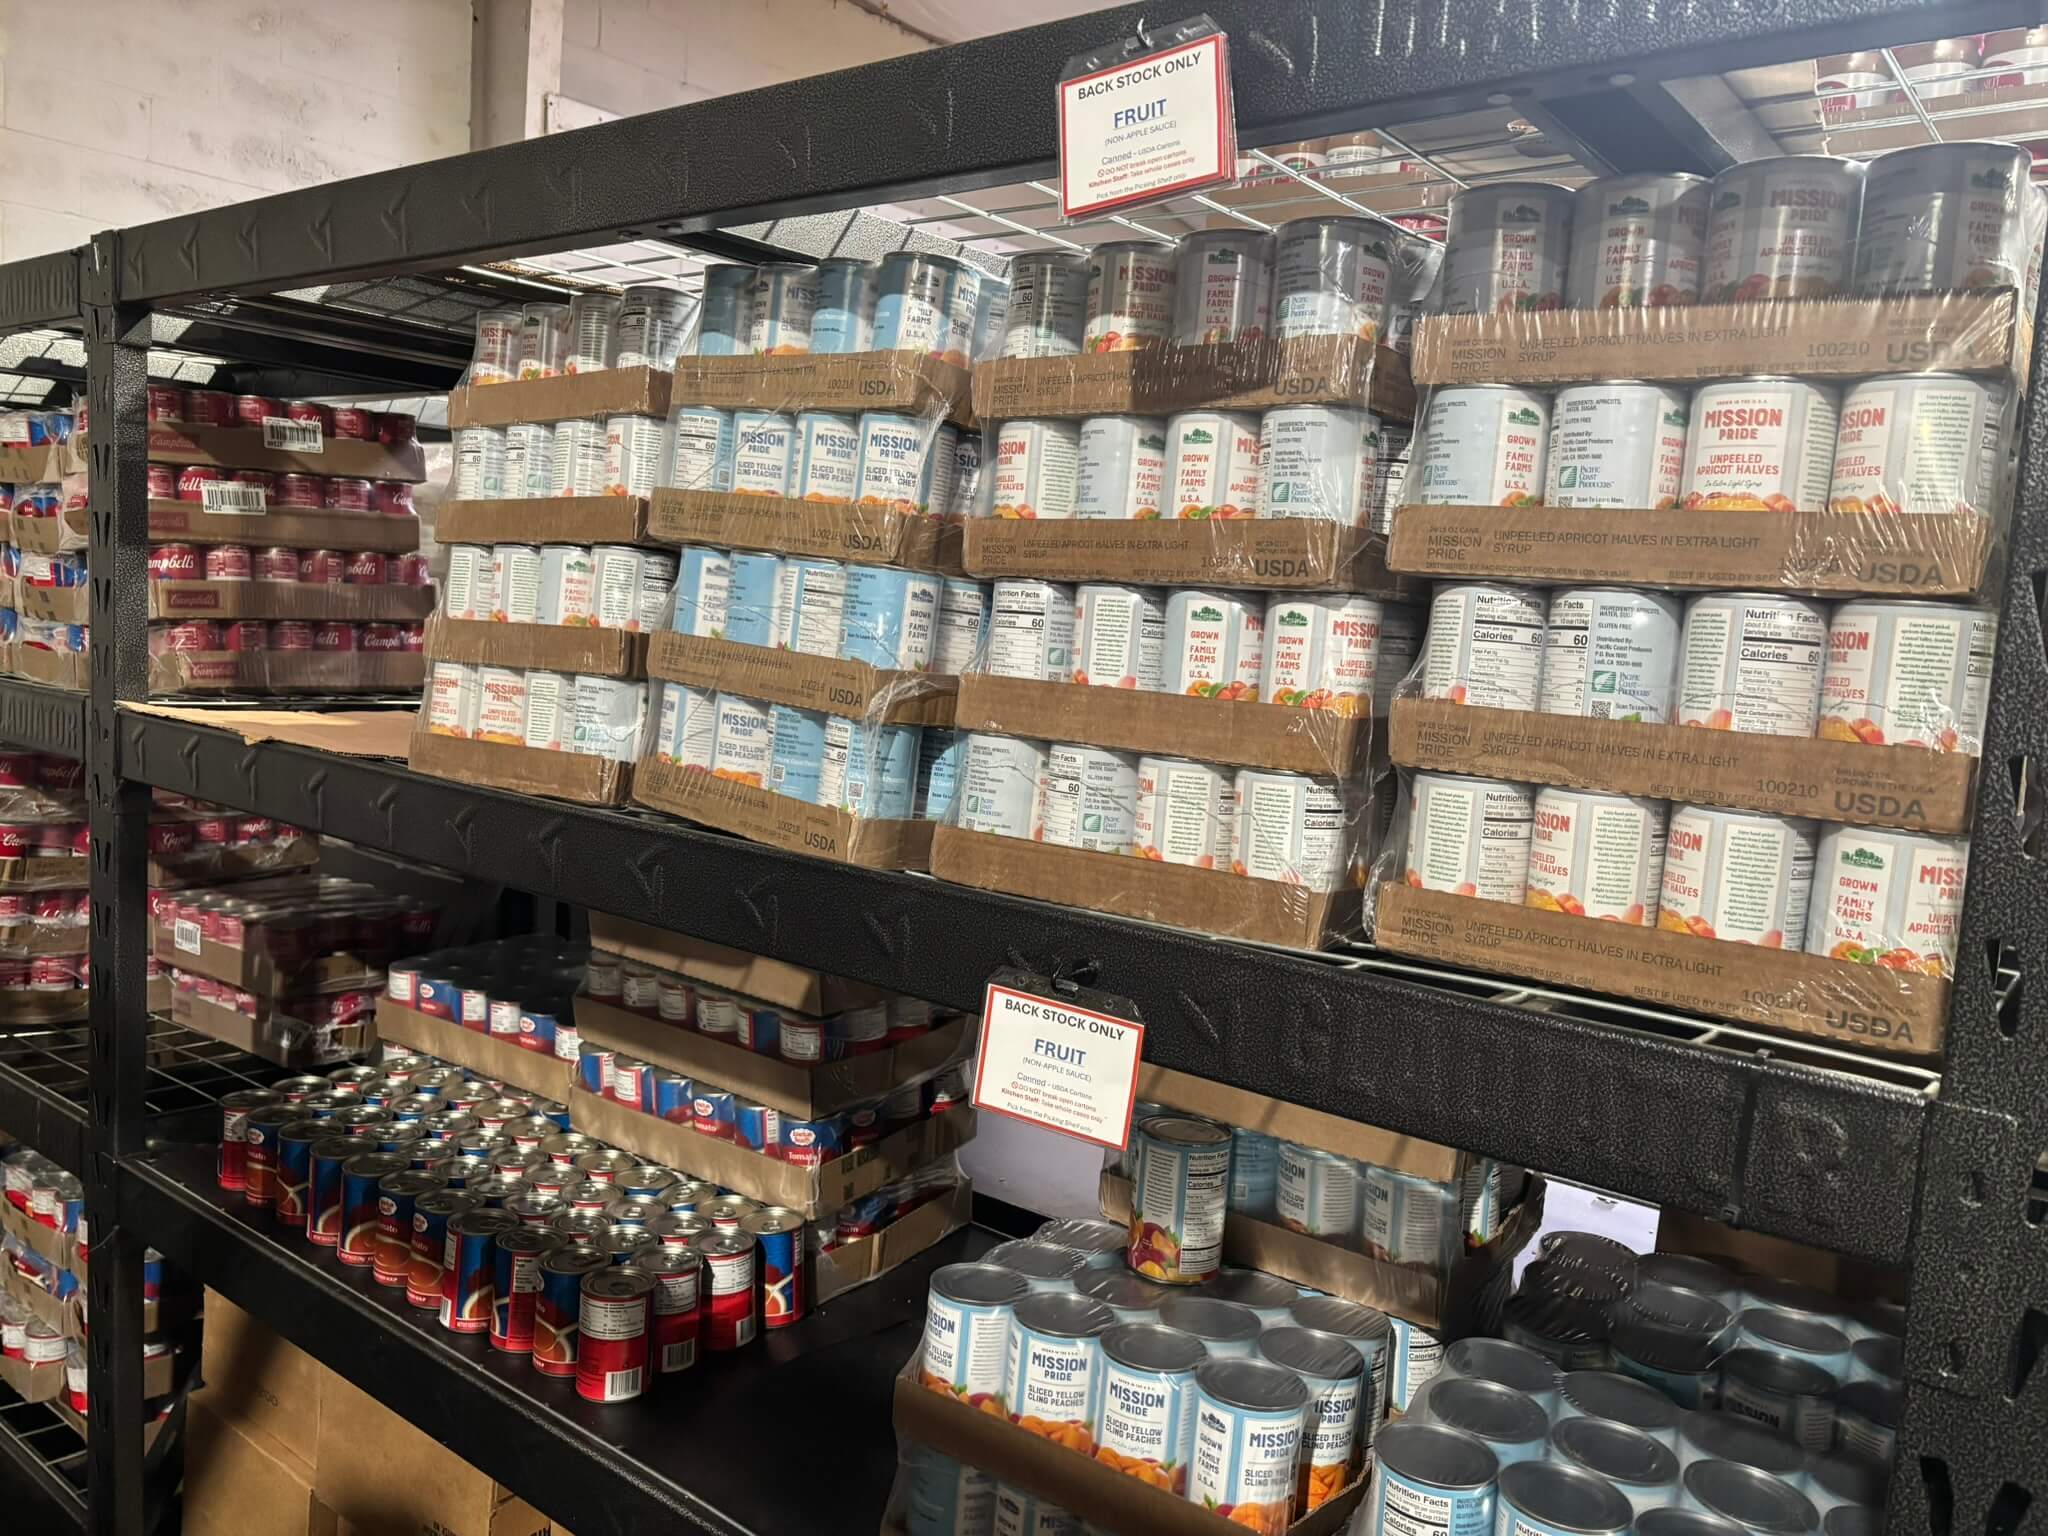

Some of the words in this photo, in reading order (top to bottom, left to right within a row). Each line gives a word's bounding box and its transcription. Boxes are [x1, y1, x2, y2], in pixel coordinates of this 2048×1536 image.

[1078, 79, 1114, 100] BACK
[1117, 64, 1161, 89] STOCK
[1164, 52, 1201, 75] ONLY
[1114, 99, 1167, 128] FRUIT
[1101, 151, 1132, 165] Canned
[1089, 179, 1112, 187] Kitchen
[1807, 342, 1870, 358] 100210
[1887, 341, 1977, 364] USDA
[859, 379, 896, 397] USDA
[1274, 376, 1329, 397] USDA
[1704, 407, 1784, 428] MISSION
[741, 431, 784, 447] MISSION
[1507, 435, 1536, 447] GROWN
[1718, 429, 1759, 440] PRIDE
[748, 445, 770, 454] PRIDE
[870, 433, 920, 452] MISSION
[879, 448, 905, 459] PRIDE
[1182, 454, 1209, 463] GROWN
[1505, 452, 1534, 462] FAMILY
[1710, 453, 1763, 465] UNPEELED
[738, 461, 754, 469] SLICED
[756, 463, 783, 471] YELLOW
[1181, 469, 1207, 478] FAMILY
[1505, 462, 1532, 473] FARMS
[1696, 465, 1733, 475] APRICOT
[1736, 464, 1779, 476] HALVES
[1181, 477, 1205, 486] FARMS
[1504, 480, 1529, 491] U.S.A.
[1180, 495, 1203, 503] U.S.A.
[842, 533, 882, 551] USDA
[1427, 535, 1482, 547] MISSION
[1493, 531, 1554, 544] UNPEELED
[1558, 533, 1608, 545] APRICOT
[1611, 533, 1658, 546] HALVES
[1661, 536, 1672, 546] IN
[1677, 535, 1721, 548] EXTRA
[1723, 537, 1760, 549] LIGHT
[1427, 549, 1465, 560] PRIDE
[1493, 543, 1532, 555] SYRUP
[148, 554, 194, 571] ampbell's
[1255, 560, 1309, 577] USDA
[1856, 560, 1944, 585] USDA
[1020, 590, 1040, 598] Facts
[1520, 599, 1541, 609] Facts
[1563, 600, 1584, 609] Facts
[1032, 618, 1044, 628] 60
[1333, 620, 1379, 638] MISSION
[1190, 631, 1219, 640] GROWN
[1473, 630, 1513, 641] Calories
[1531, 633, 1543, 643] 60
[1574, 634, 1588, 646] 60
[1190, 645, 1216, 655] FAMILY
[1347, 638, 1371, 649] PRIDE
[1189, 654, 1216, 664] FARMS
[1741, 648, 1789, 661] Calories
[1808, 651, 1819, 663] 60
[1189, 670, 1213, 679] U.S.A.
[828, 686, 862, 708] USDA
[1068, 783, 1080, 793] 60
[1306, 786, 1338, 795] Nutrition
[1757, 780, 1819, 799] 100210
[1486, 792, 1520, 802] Nutrition
[1834, 791, 1926, 821] USDA
[1304, 818, 1336, 828] Calories
[1482, 828, 1518, 838] Calories
[804, 831, 836, 852] USDA
[1536, 862, 1568, 877] HALVES
[1839, 876, 1879, 893] GROWN
[1837, 895, 1874, 911] FAMILY
[1835, 906, 1873, 921] FARMS
[1401, 918, 1454, 934] MISSION
[1401, 928, 1438, 945] PRIDE
[1464, 933, 1501, 949] SYRUP
[1835, 927, 1867, 942] U.S.A.
[1465, 920, 1523, 940] UNPEELED
[1525, 931, 1575, 950] APRICOT
[1577, 942, 1623, 958] HALVES
[1626, 949, 1639, 961] IN
[1642, 952, 1683, 970] EXTRA
[1684, 962, 1724, 977] LIGHT
[1004, 998, 1039, 1018] BACK
[1042, 1009, 1086, 1030] STOCK
[1089, 1022, 1125, 1040] ONLY
[1826, 1009, 1914, 1044] USDA
[1034, 1038, 1086, 1065] FRUIT
[1023, 1057, 1064, 1074] (NON-APPLE
[1066, 1068, 1092, 1081] SAUCE)
[1017, 1072, 1046, 1087] Canned
[1052, 1084, 1068, 1092] USDA
[1002, 1088, 1023, 1098] Kitchen
[1007, 1102, 1018, 1110] Pick
[1020, 1106, 1032, 1114] from
[1044, 1113, 1064, 1125] Picking
[1074, 1101, 1096, 1112] cartons
[1032, 1352, 1087, 1371] MISSION
[1044, 1370, 1072, 1382] PRIDE
[1028, 1384, 1054, 1397] SLICED
[1056, 1391, 1085, 1400] YELLOW
[1110, 1381, 1164, 1408] MISSION
[1028, 1393, 1048, 1404] CLING
[1050, 1397, 1085, 1407] PEACHES
[1120, 1404, 1148, 1417] PRIDE
[1106, 1415, 1129, 1431] SLICED
[1131, 1424, 1162, 1437] YELLOW
[1105, 1426, 1124, 1440] CLING
[1125, 1432, 1162, 1445] PEACHES
[1250, 1432, 1300, 1448] MISSION
[1264, 1447, 1289, 1459] PRIDE
[1387, 1480, 1420, 1502] Nutrition
[1424, 1496, 1448, 1508] Facts
[1384, 1512, 1417, 1535] Calories
